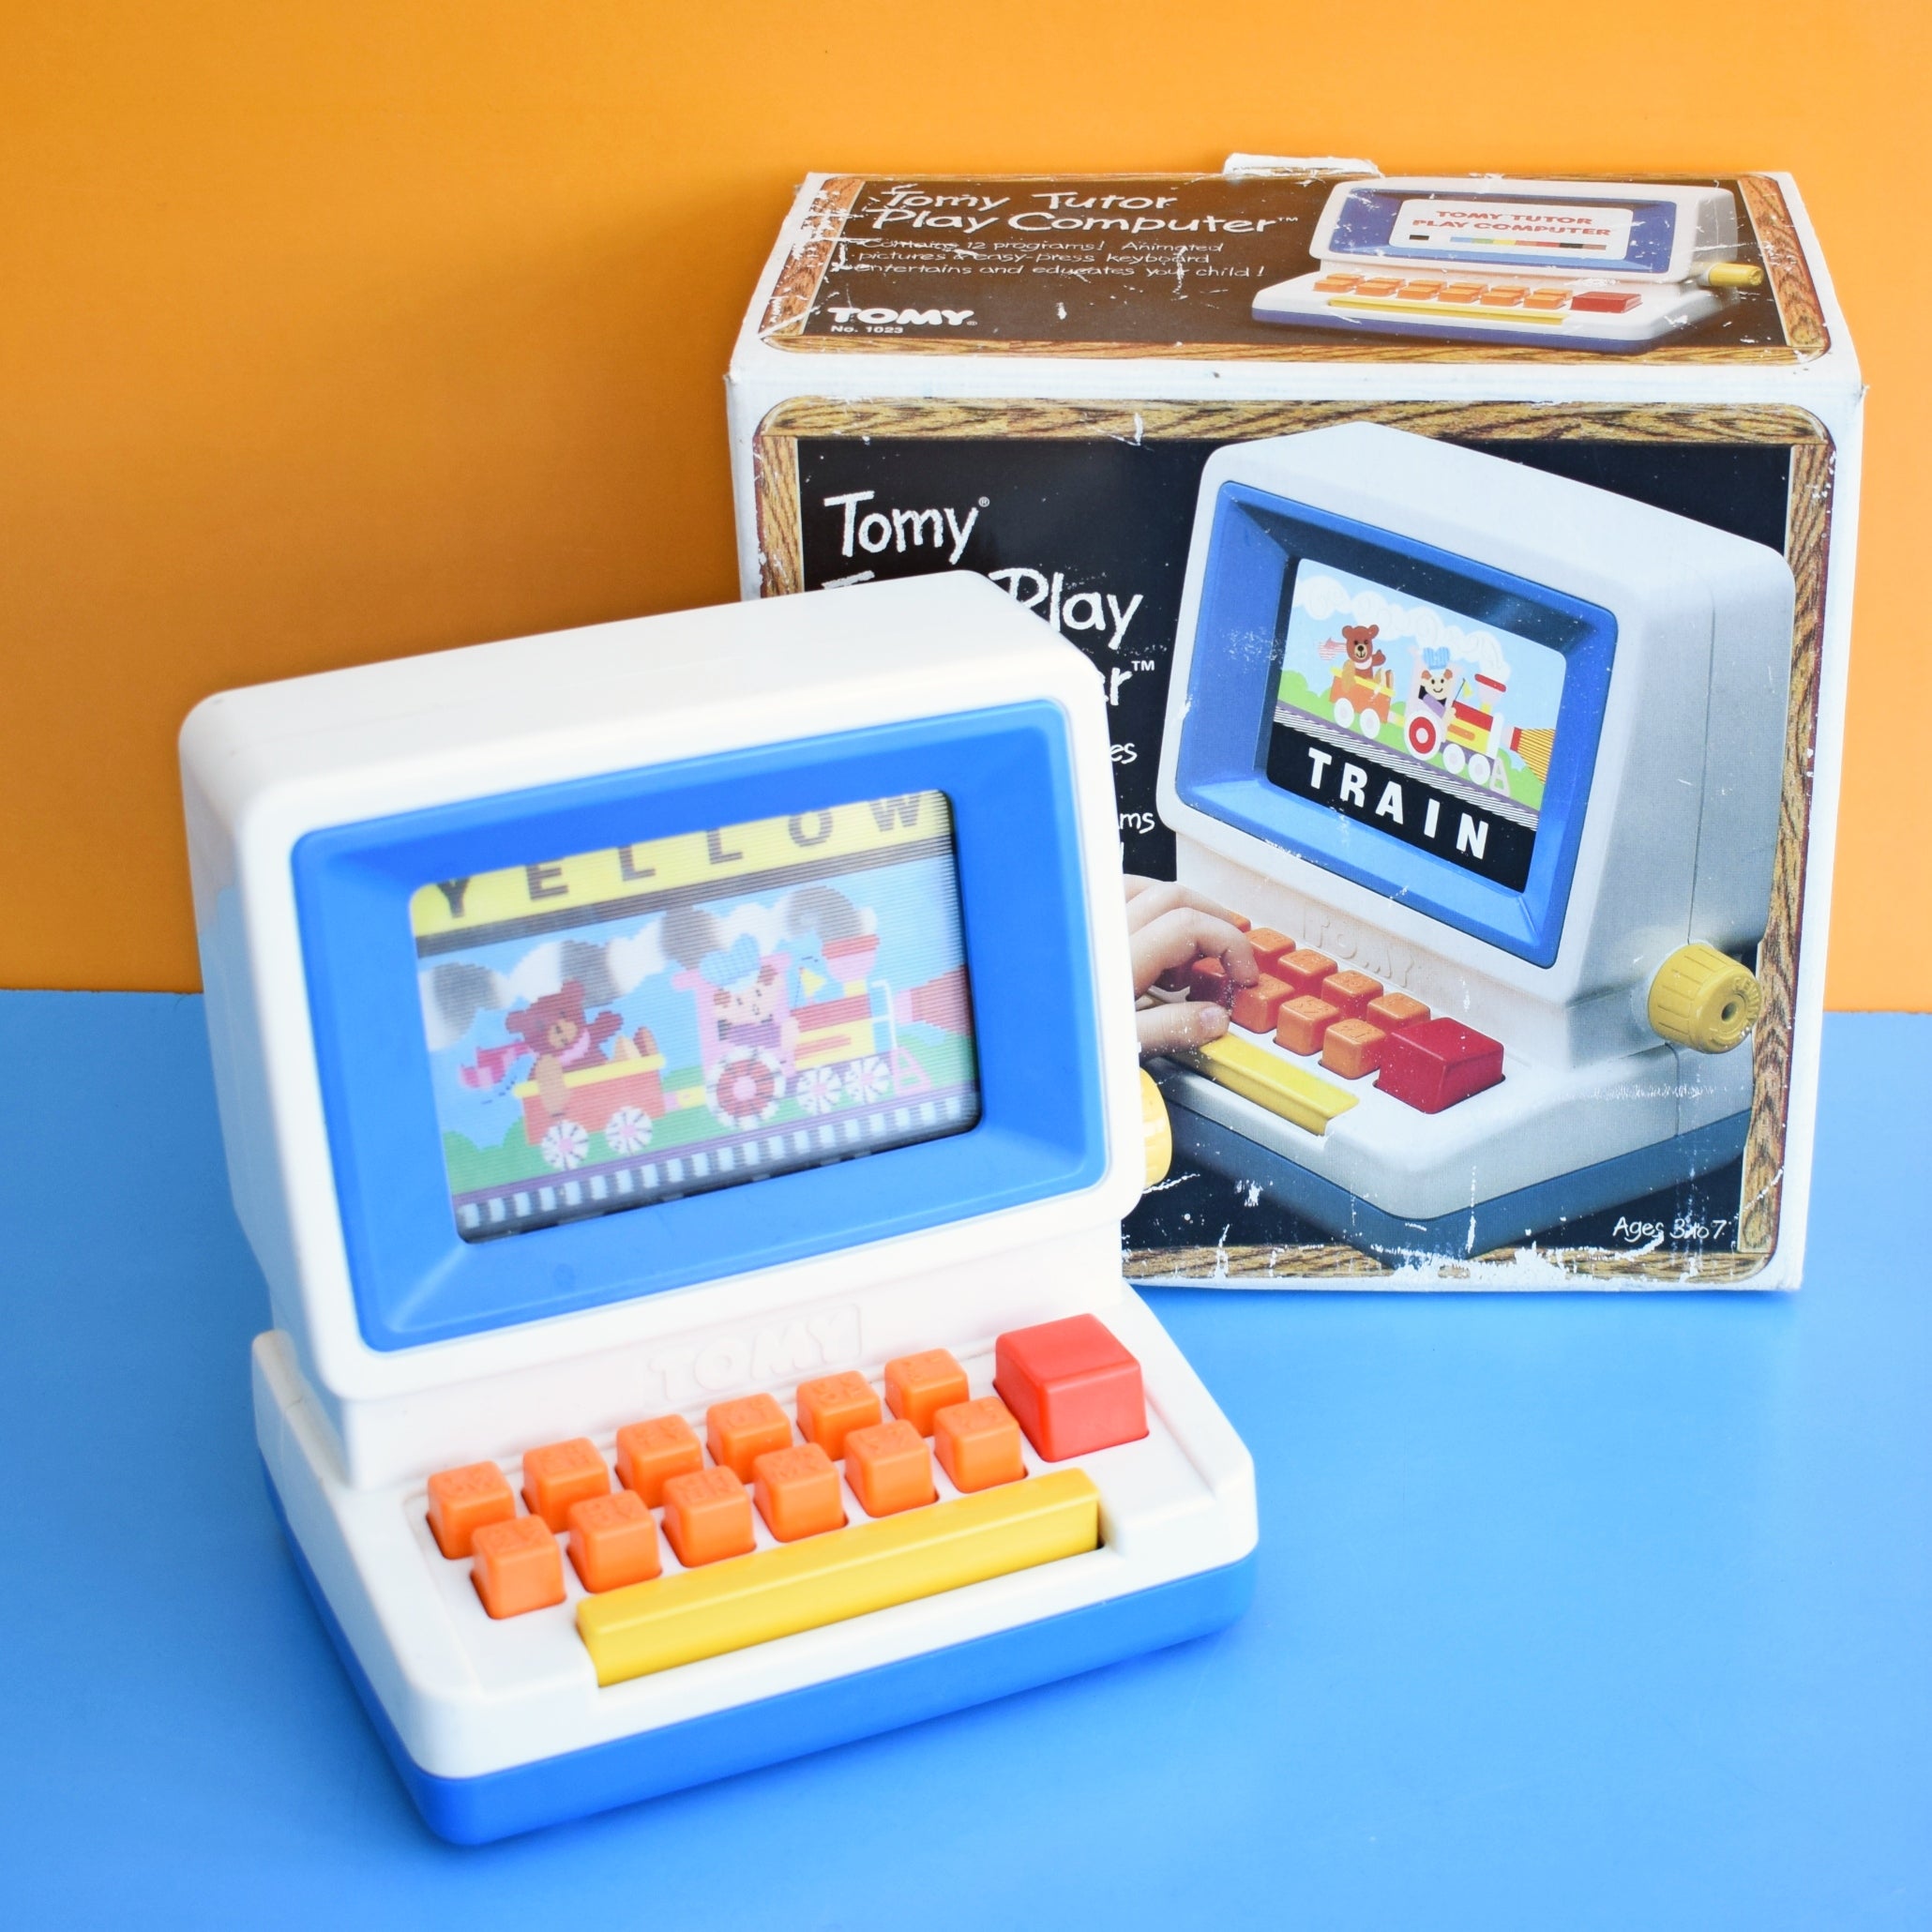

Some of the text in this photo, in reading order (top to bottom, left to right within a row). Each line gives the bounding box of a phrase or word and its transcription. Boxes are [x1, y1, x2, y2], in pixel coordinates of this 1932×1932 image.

[881, 190, 1178, 212] Tomy Tutor
[865, 207, 1001, 234] Play
[1411, 219, 1611, 235] PLAY COMPUTER
[1436, 210, 1593, 224] TOMY TUTOR
[863, 238, 1225, 252] Contains 12 programs! Animated
[858, 250, 947, 261] pictures
[973, 252, 1096, 263] easy-press
[1105, 252, 1210, 265] keyboard
[853, 264, 973, 275] entertains
[978, 264, 1025, 275] and
[1032, 264, 1136, 276] educates
[1145, 266, 1190, 278] your
[830, 325, 904, 334] No. 1023
[987, 566, 1144, 651] Play
[1307, 747, 1489, 860] TRAIN
[435, 792, 923, 920] YELLOW
[1611, 1215, 1665, 1244] Ages
[1669, 1218, 1685, 1239] 3
[1711, 1219, 1728, 1240] 7
[645, 1306, 855, 1407] TOMY
